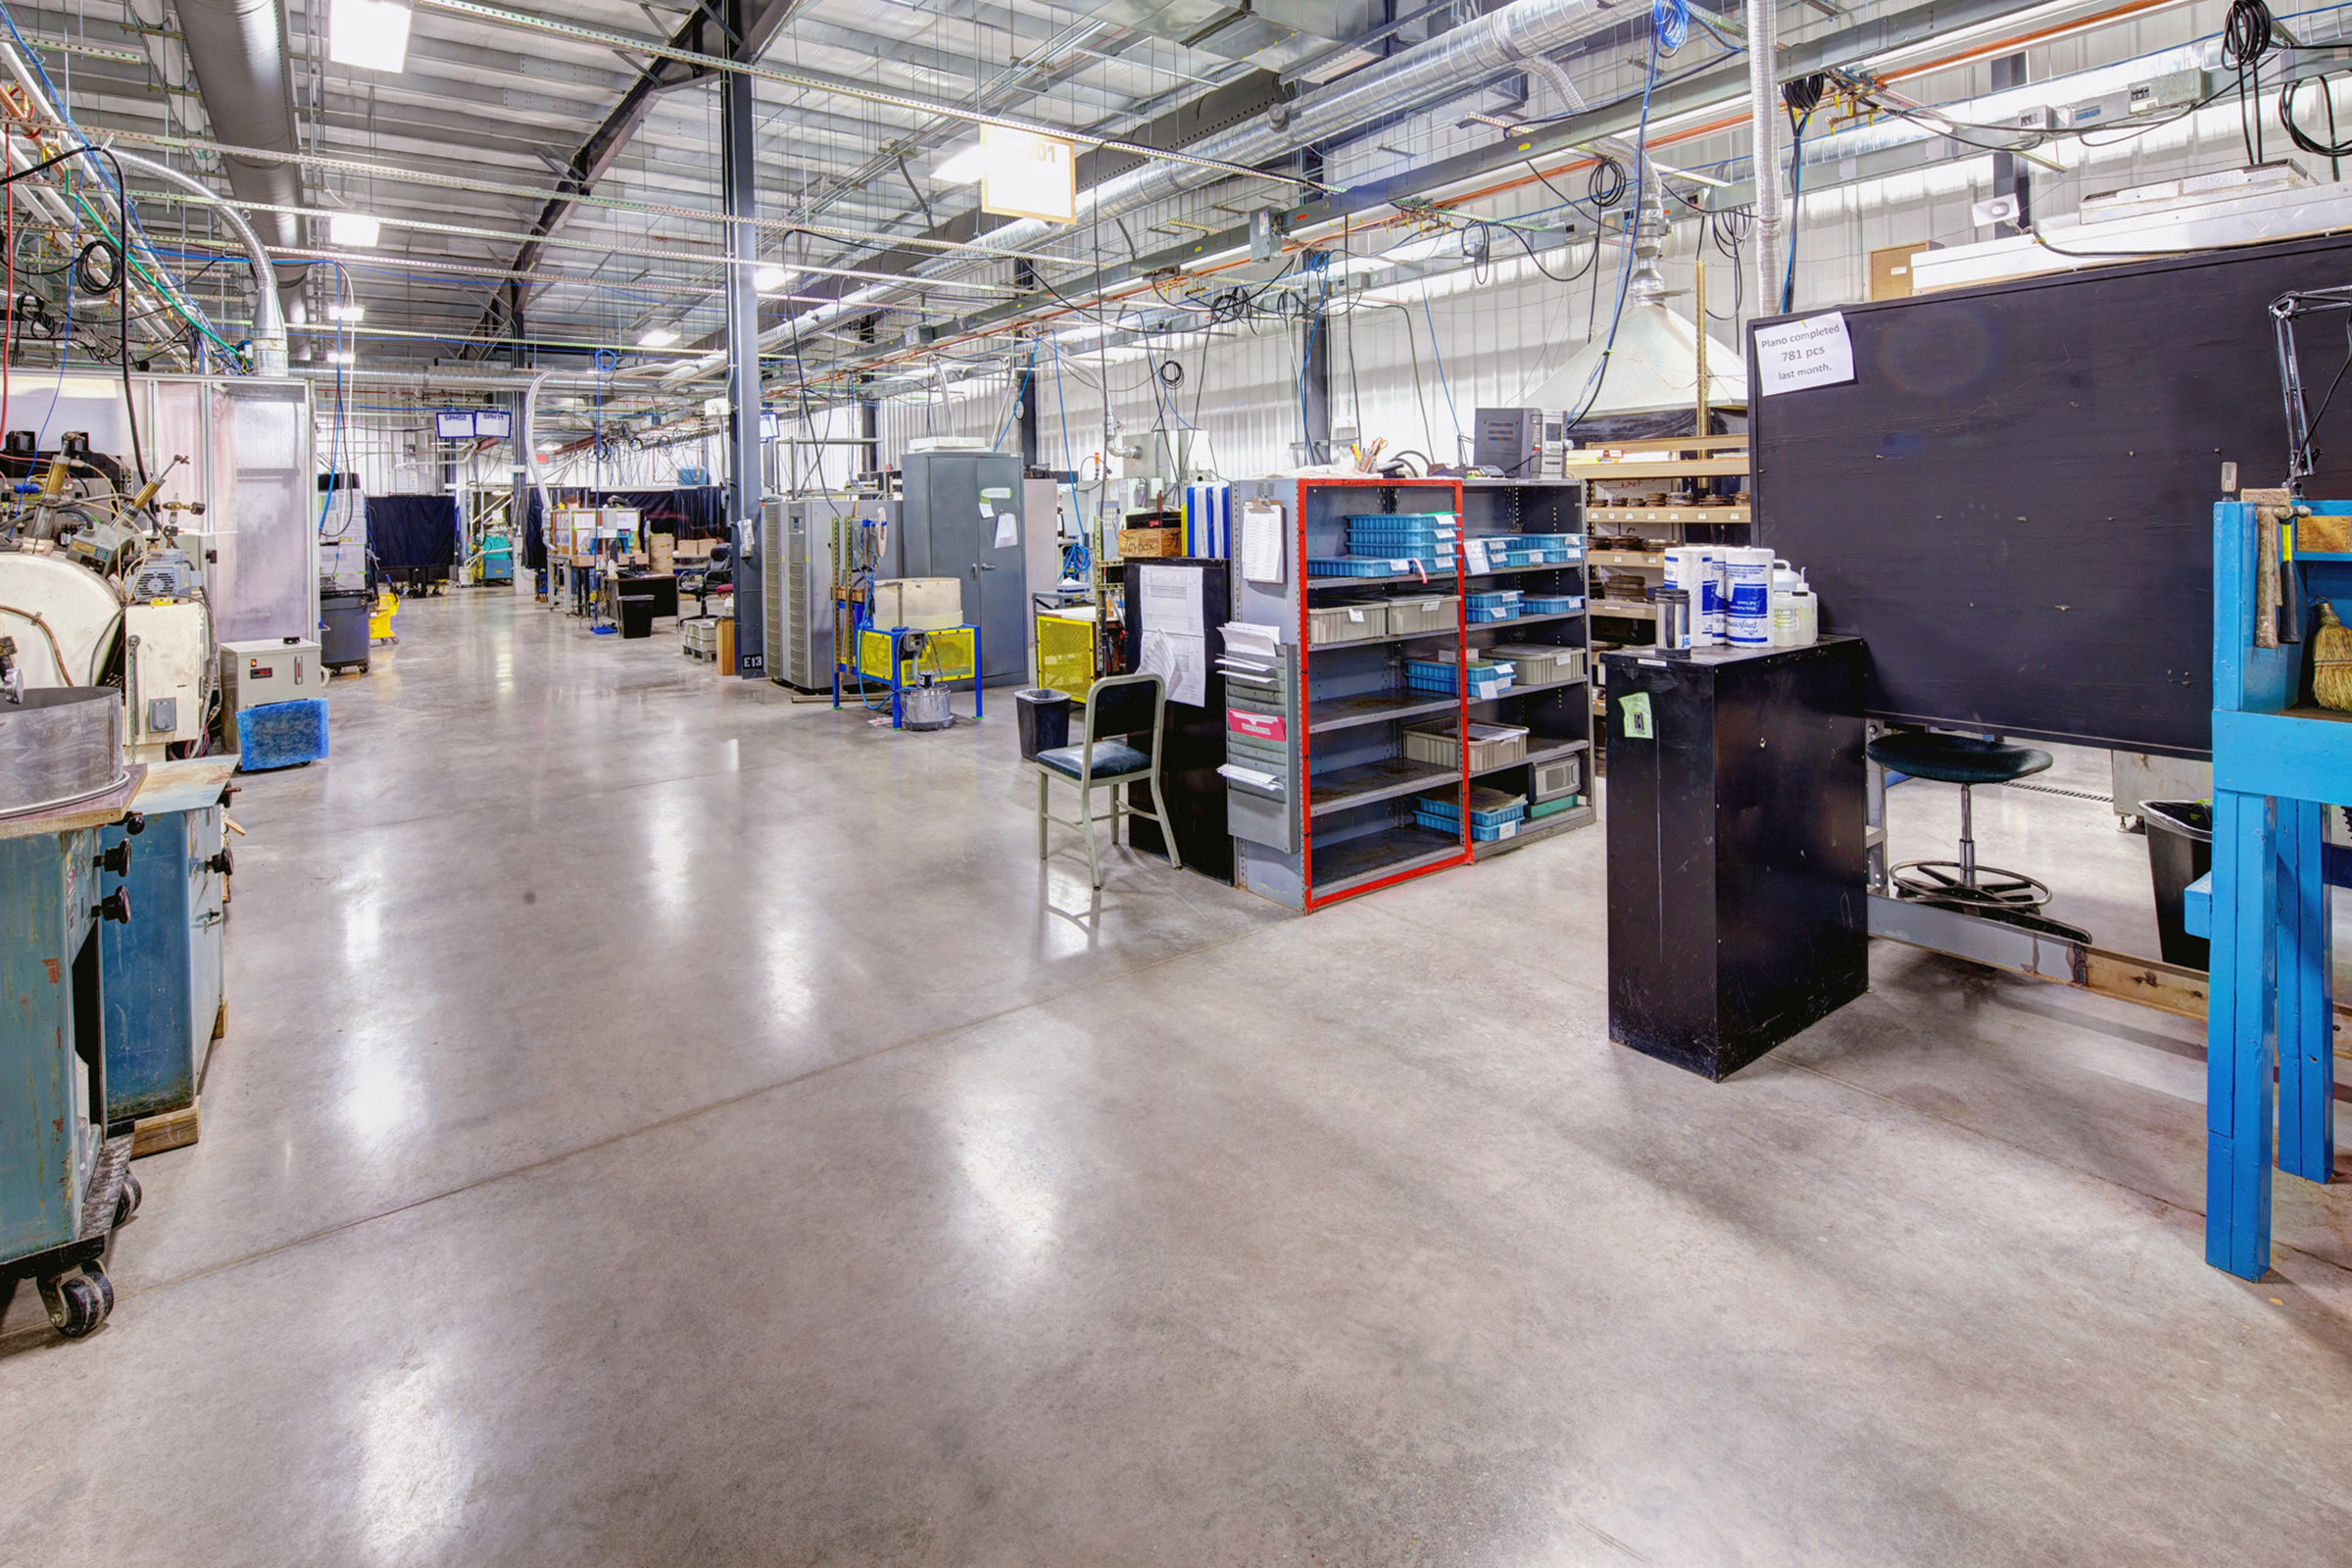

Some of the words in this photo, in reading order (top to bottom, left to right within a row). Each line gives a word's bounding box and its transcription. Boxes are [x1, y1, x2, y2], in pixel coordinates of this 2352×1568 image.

[1761, 337, 1788, 349] Plano
[1789, 324, 1840, 343] completed
[1782, 349, 1803, 362] 781
[1805, 346, 1826, 359] pcs
[1778, 370, 1795, 380] last
[1797, 363, 1833, 377] month.
[1120, 532, 1155, 555] Toybox
[744, 656, 762, 667] E13
